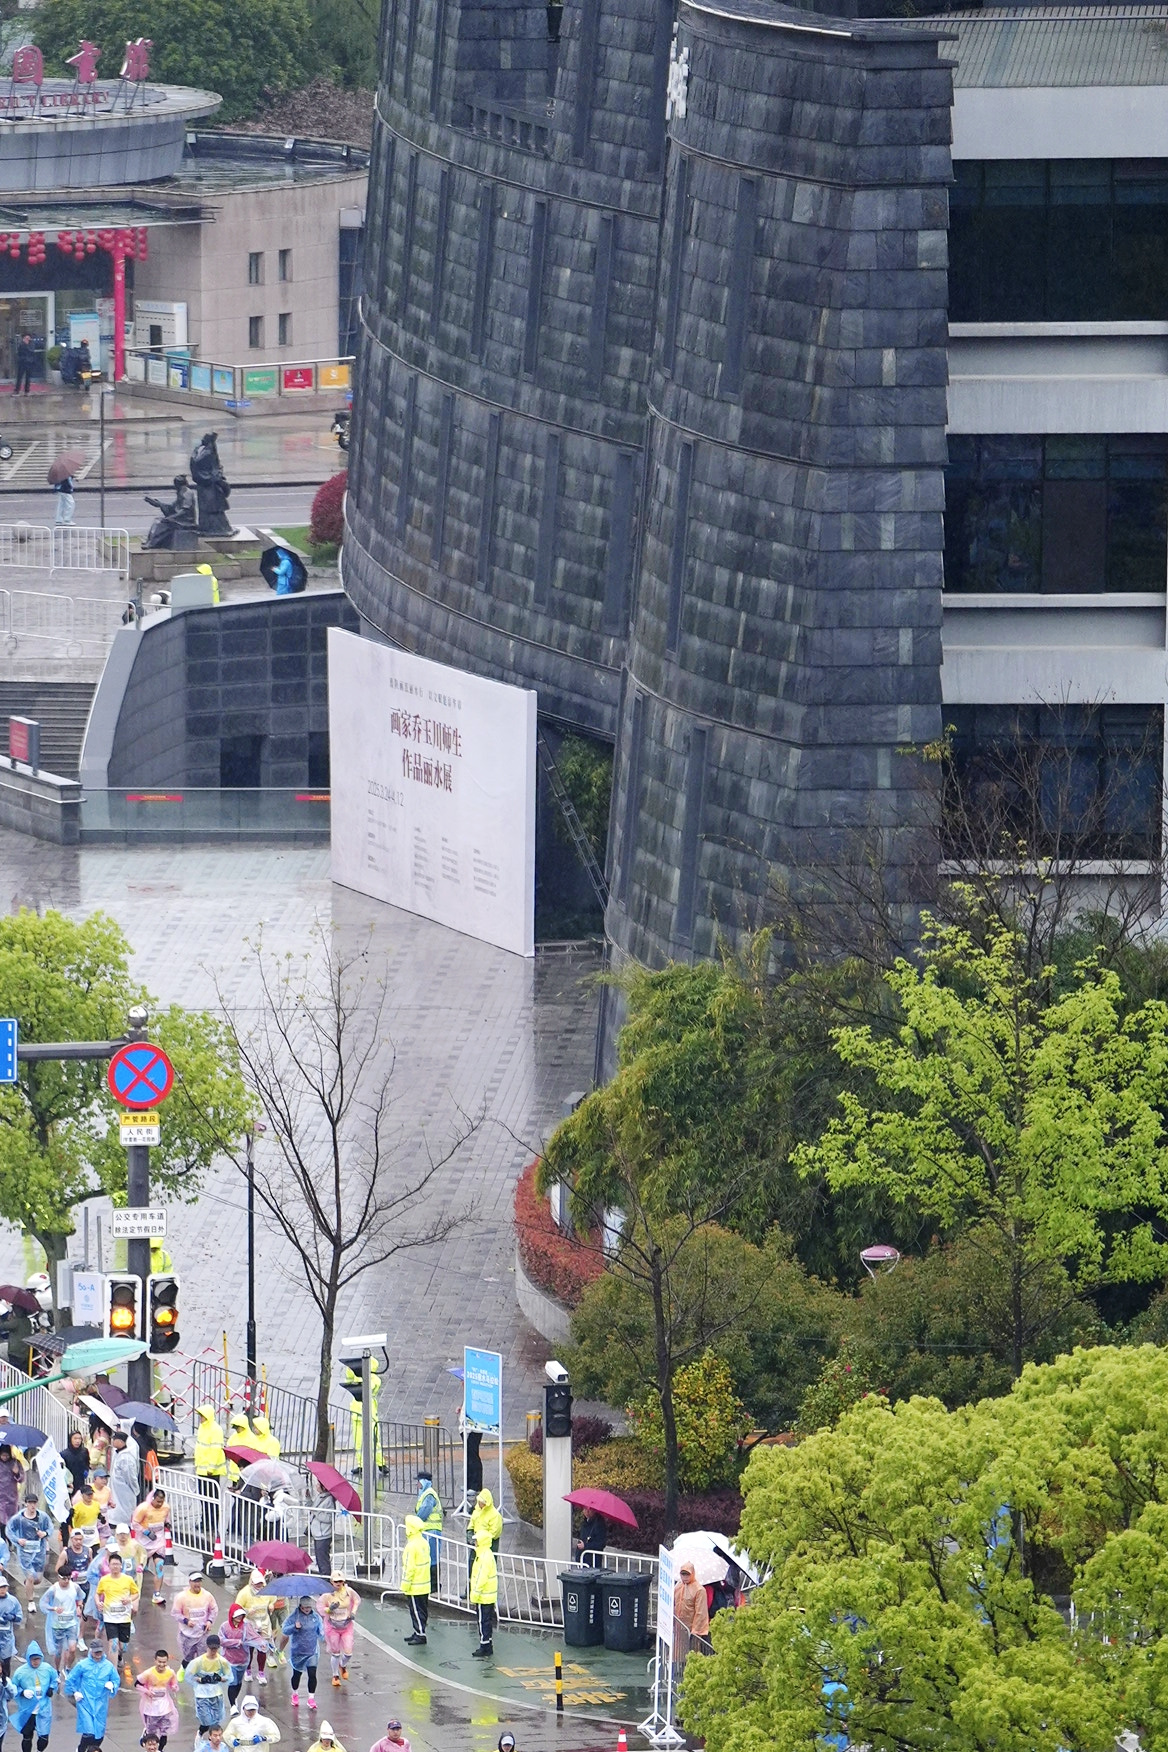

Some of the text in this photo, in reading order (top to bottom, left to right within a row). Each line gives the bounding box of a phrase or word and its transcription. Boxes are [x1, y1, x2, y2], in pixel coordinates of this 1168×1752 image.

[42, 91, 109, 107] LIBRARY
[390, 707, 463, 757] 画家乔玉川师生
[402, 748, 452, 793] 作品丽水展
[123, 1115, 157, 1123] 严管路段
[127, 1128, 153, 1136] 人民街
[115, 1212, 165, 1221] 公交专用车道
[115, 1225, 165, 1234] 除法定节假日外
